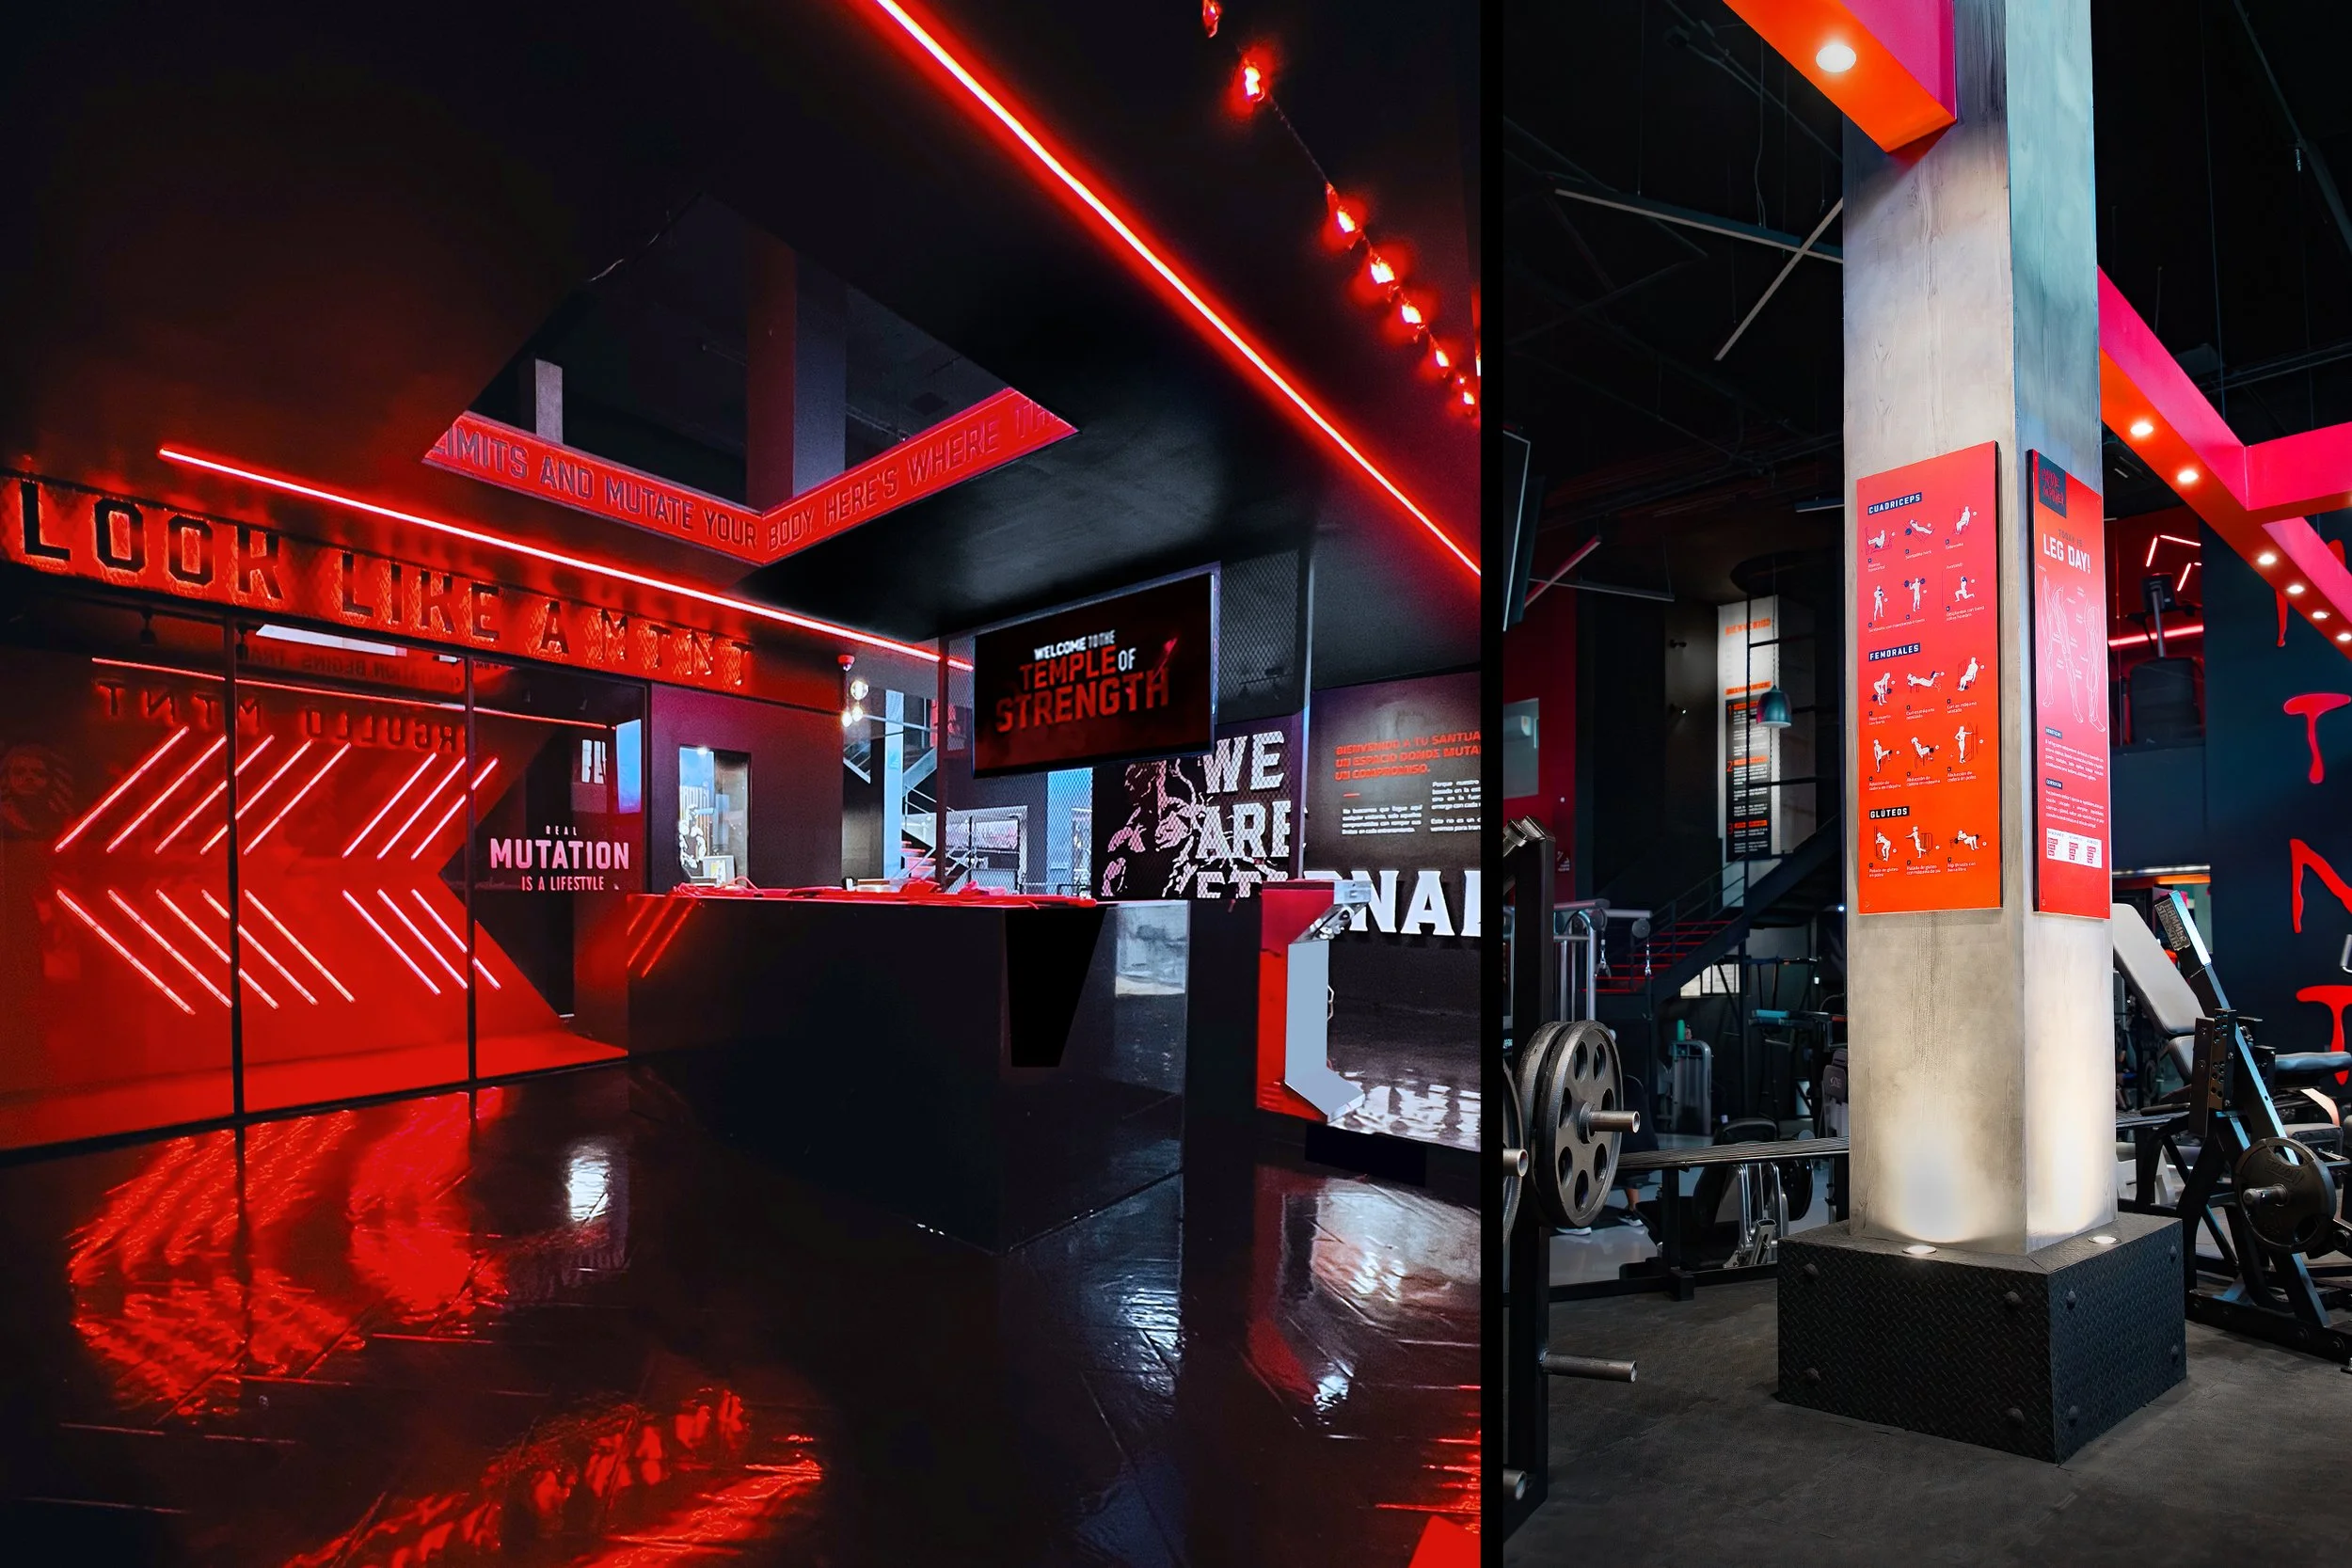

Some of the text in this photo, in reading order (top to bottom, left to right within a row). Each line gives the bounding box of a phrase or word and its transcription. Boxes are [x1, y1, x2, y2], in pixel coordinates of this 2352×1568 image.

[541, 456, 594, 499] AND
[606, 477, 693, 530] MUTATE
[703, 510, 757, 549] YOUR
[768, 506, 815, 552] BODY
[823, 467, 899, 527] HERE'S
[907, 415, 1001, 487] WHERE
[1867, 493, 1922, 515] CUADRICEPS
[2042, 532, 2091, 576] LEG DAY!
[20, 482, 284, 599] LOOK
[342, 553, 501, 641] LIKE
[539, 600, 569, 655] A
[1034, 637, 1087, 660] WELCOME
[1869, 643, 1919, 661] FEMORALES
[1020, 644, 1137, 690] TEMPLE OF
[994, 666, 1169, 733] STRENGTH
[1335, 738, 1400, 756] BIENVENIDO
[1414, 737, 1429, 748] TU
[1335, 745, 1481, 768] UN ESPACIO DONDE MUTA
[1201, 730, 1285, 794] WE
[1334, 763, 1431, 781] UN COMPROMISO.
[1869, 806, 1908, 819] GLÚTEOS
[545, 825, 578, 836] REAL
[1195, 800, 1307, 859] ARE
[490, 838, 630, 870] MUTATION
[521, 876, 605, 891] IS A LIFESTYLE
